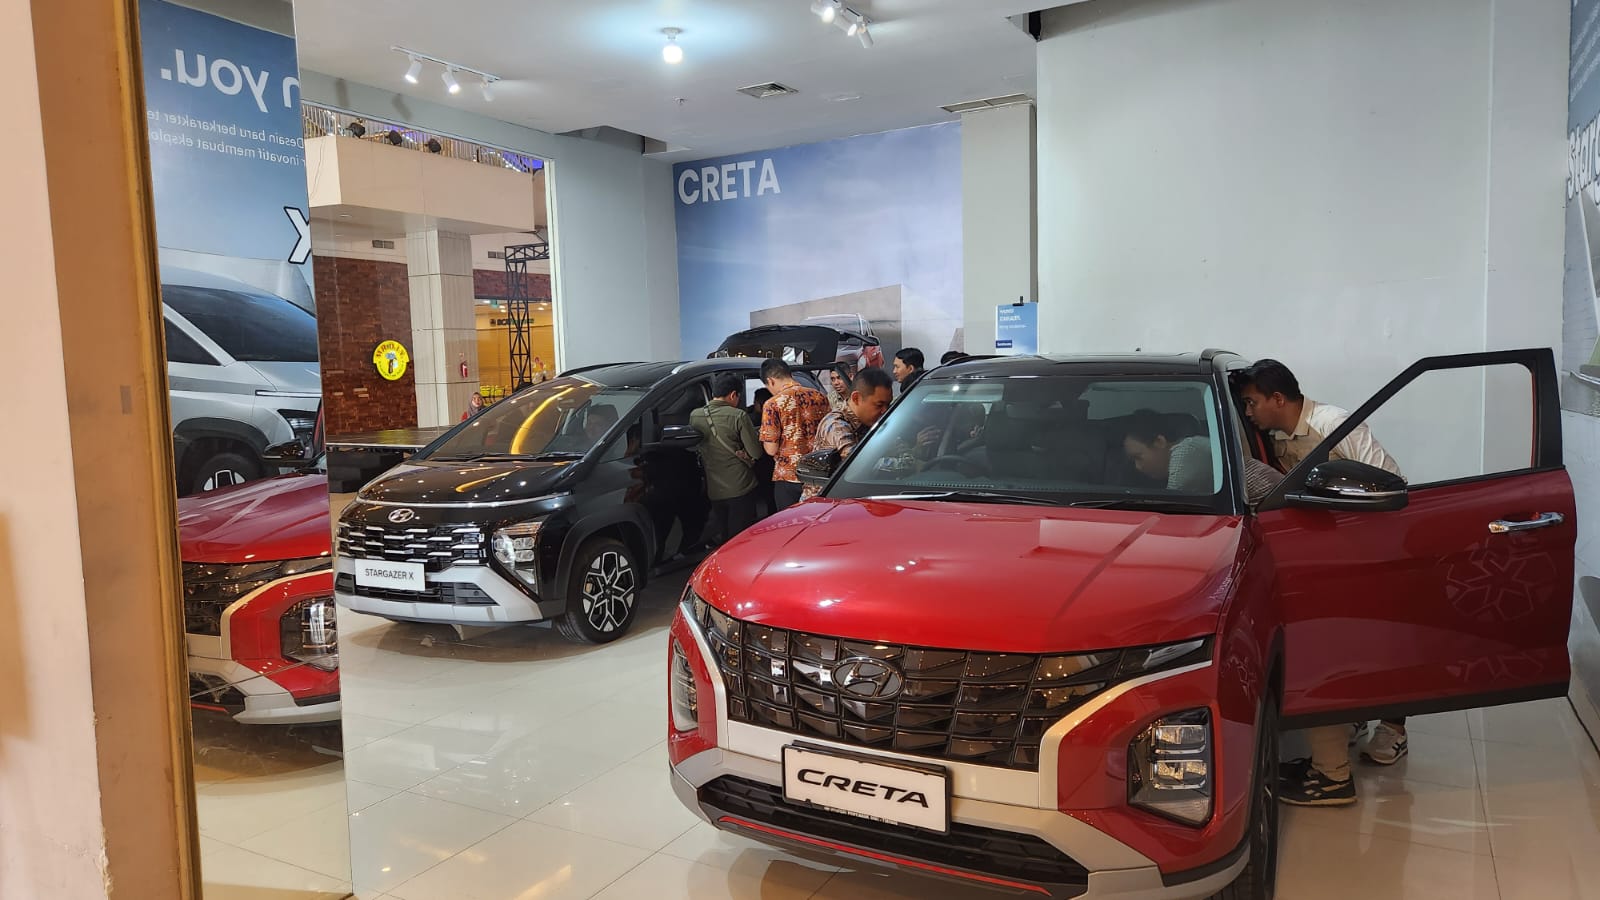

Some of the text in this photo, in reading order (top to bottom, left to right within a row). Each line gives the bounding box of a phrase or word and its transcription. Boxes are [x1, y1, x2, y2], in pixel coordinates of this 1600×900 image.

[678, 158, 781, 205] CRETA
[365, 568, 415, 581] STARGAZER X
[797, 768, 930, 809] CRETA
